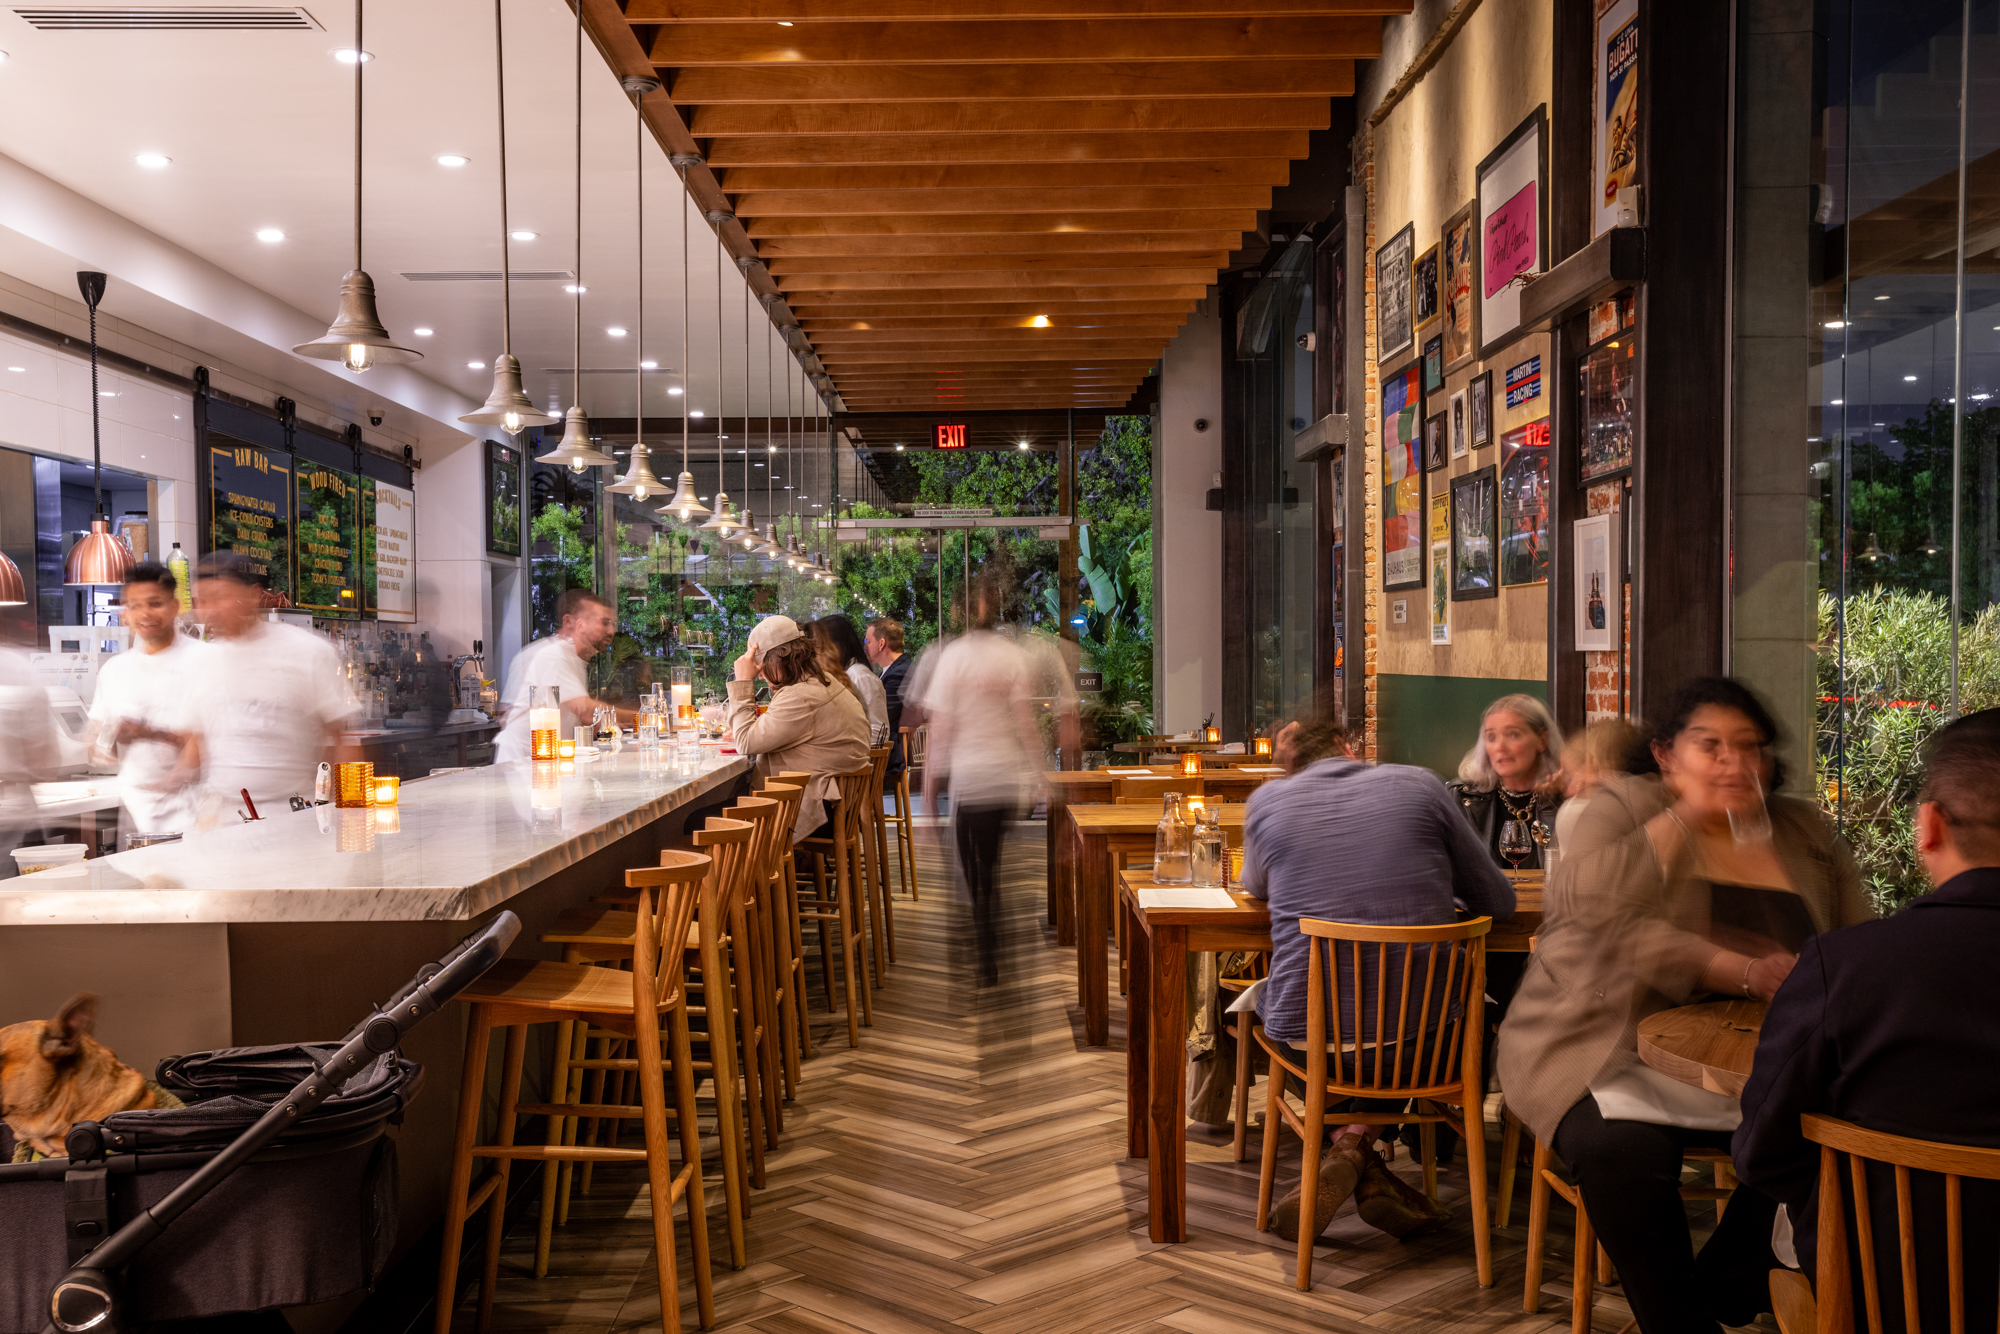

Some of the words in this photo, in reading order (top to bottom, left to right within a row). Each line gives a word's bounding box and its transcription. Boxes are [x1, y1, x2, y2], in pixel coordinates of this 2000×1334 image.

[1512, 361, 1532, 382] MARTINI
[1514, 383, 1533, 404] RACING
[938, 424, 966, 448] EXIT
[234, 448, 251, 467] RAW
[254, 451, 268, 474] BAR
[310, 471, 327, 490] WOOD
[329, 473, 346, 498] FIRED
[375, 489, 401, 511] COCKTAILS
[230, 510, 253, 524] ICE-COLD
[254, 515, 274, 528] OYSTERS
[237, 528, 250, 540] DAILY
[250, 546, 272, 560] COCKTAIL
[249, 563, 268, 576] TARTARE
